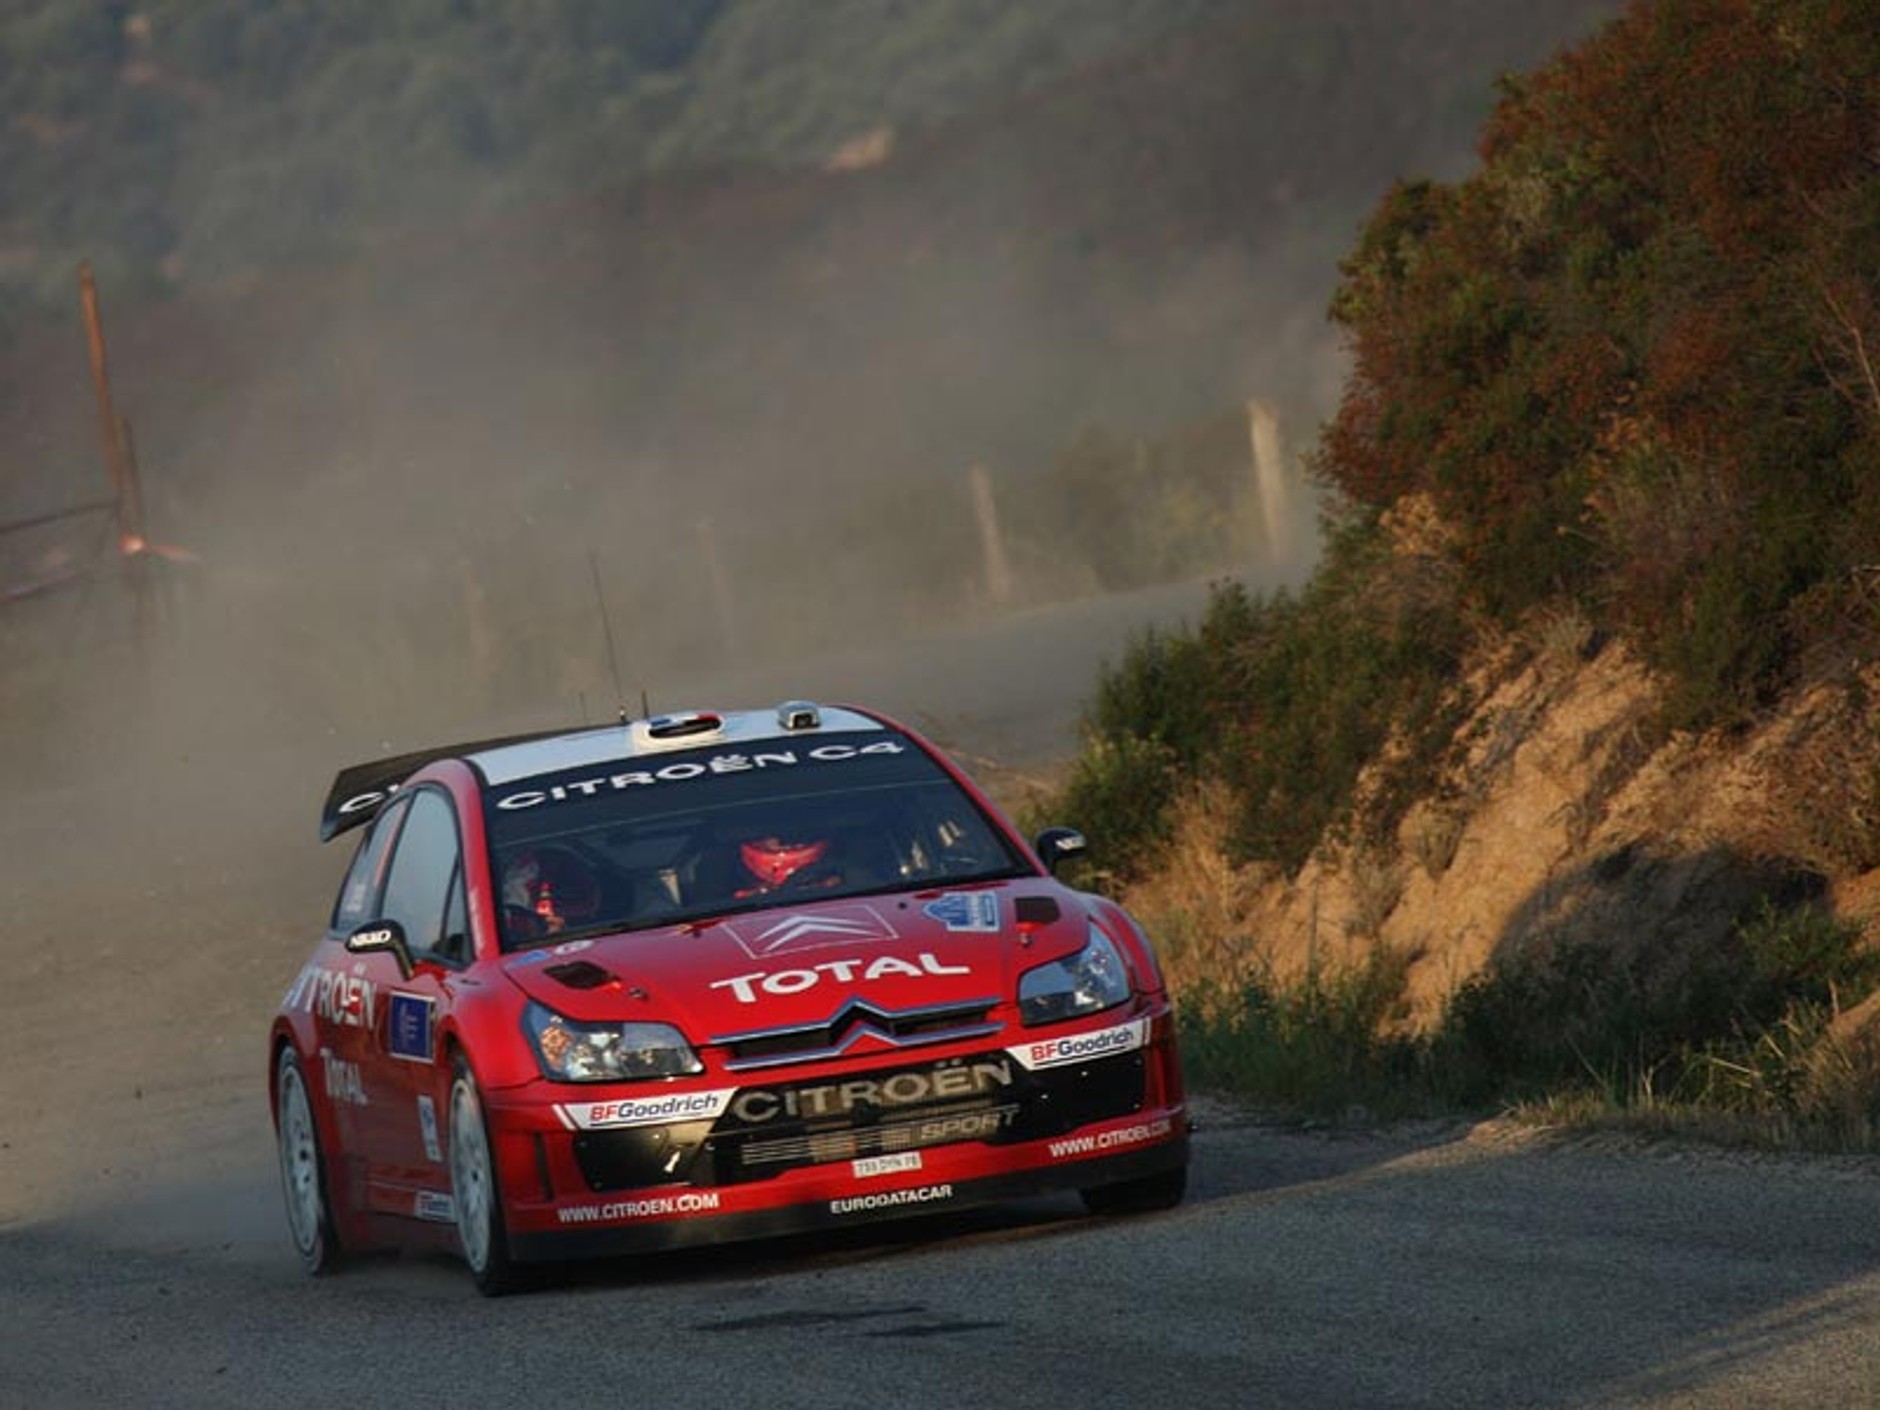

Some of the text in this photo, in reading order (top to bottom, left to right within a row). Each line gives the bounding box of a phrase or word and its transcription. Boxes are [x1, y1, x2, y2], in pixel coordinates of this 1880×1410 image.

[496, 740, 904, 810] CITROËN C4
[709, 953, 970, 1003] TOTAL
[1031, 1027, 1134, 1061] BFGoodrich
[589, 1093, 718, 1121] BFGoodrich
[731, 1058, 1013, 1123] CITROËN
[921, 1103, 1020, 1139] SPORT
[557, 1193, 719, 1223] WWW.CITROEN.COM
